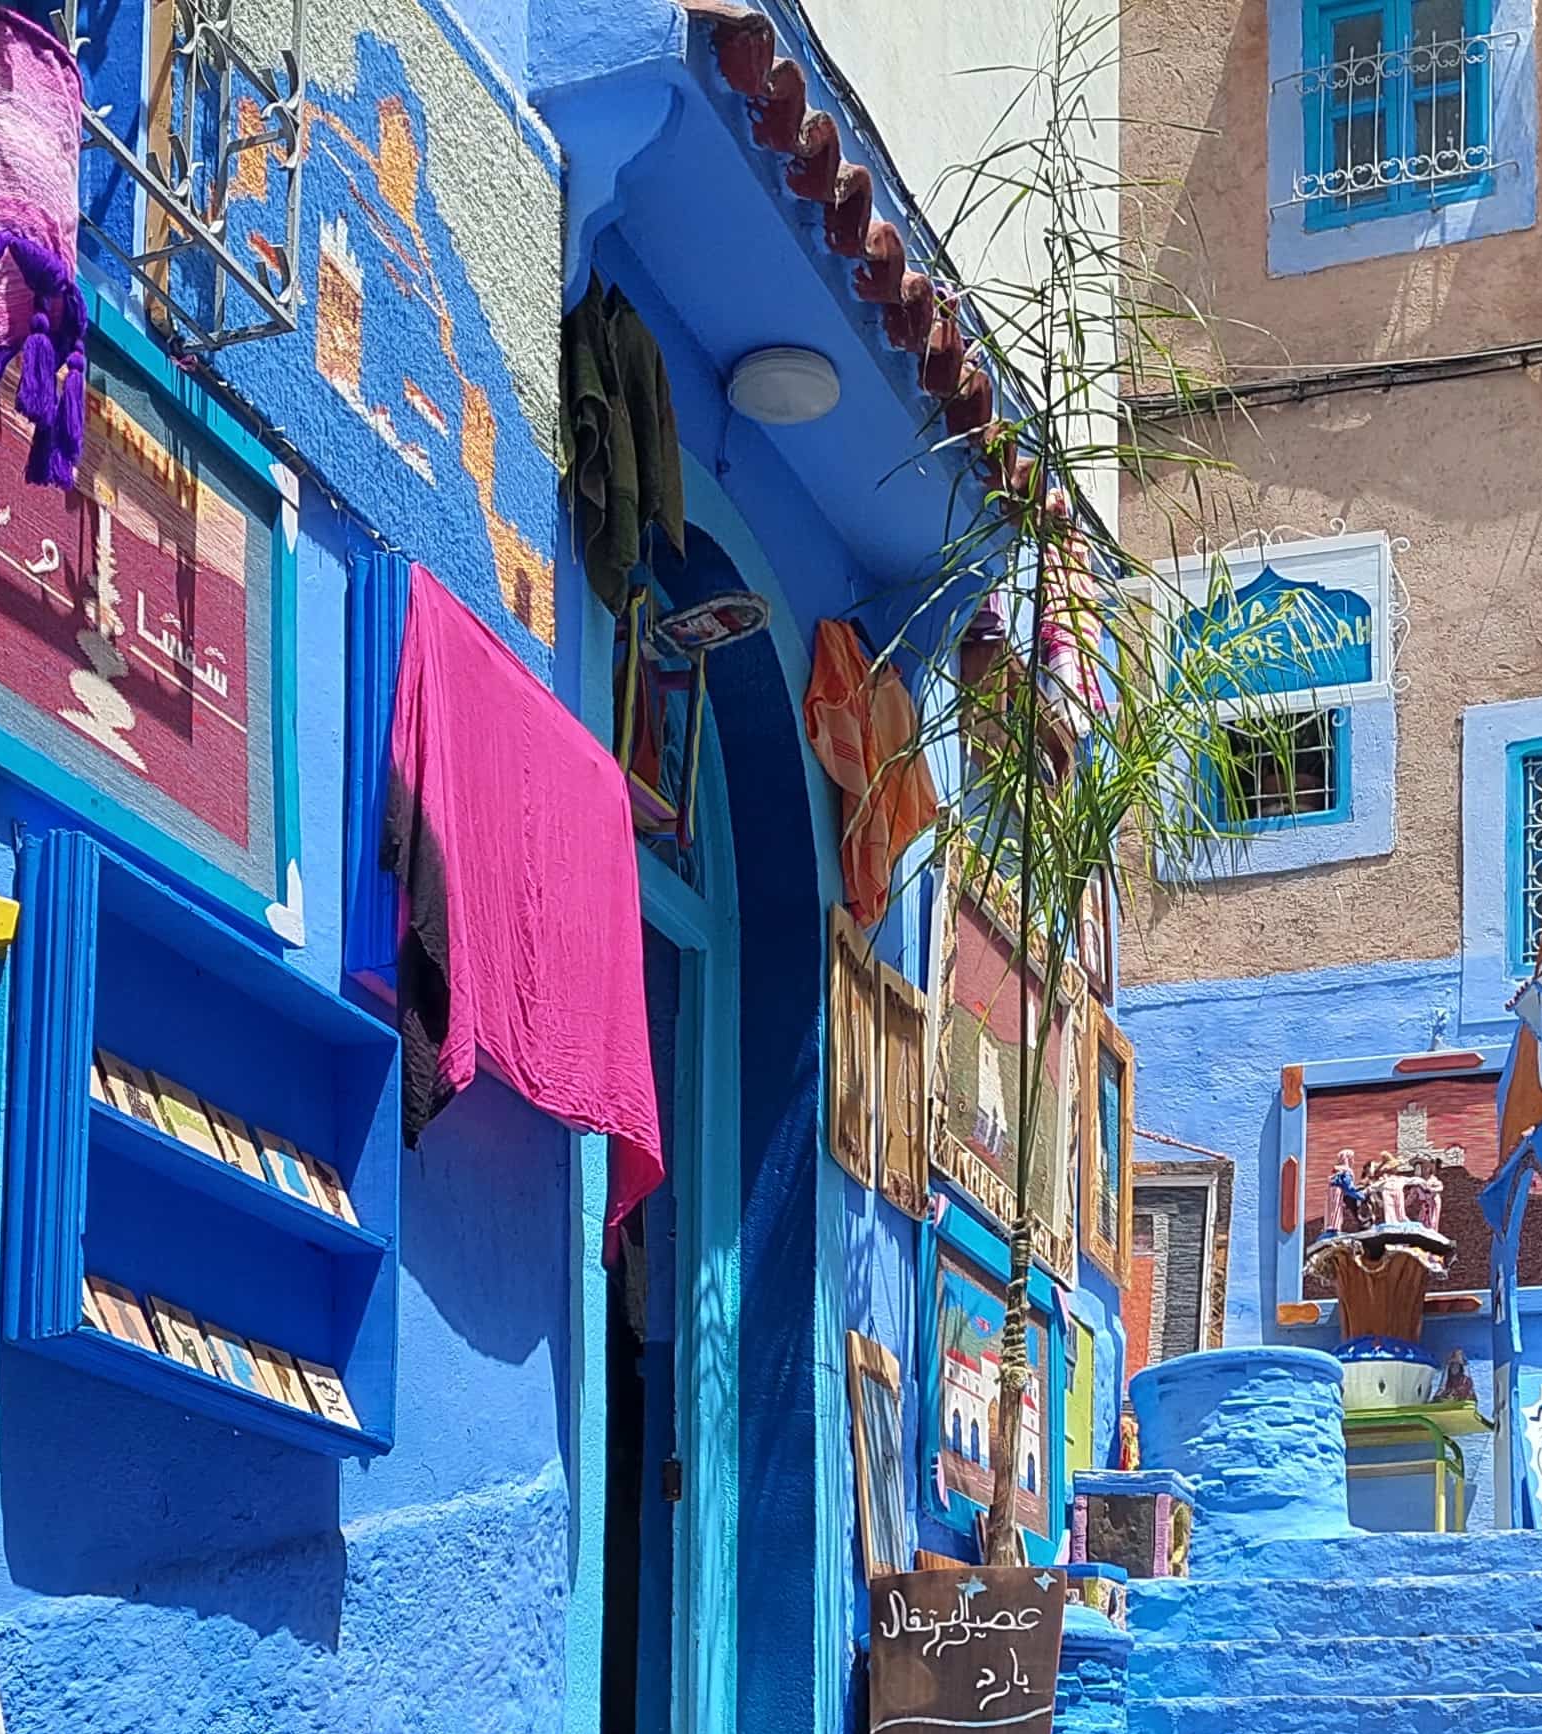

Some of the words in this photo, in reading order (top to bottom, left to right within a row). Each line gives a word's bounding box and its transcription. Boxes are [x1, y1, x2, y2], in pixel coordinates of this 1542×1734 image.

[880, 1589, 970, 1657] البرتقال
[937, 1607, 1043, 1657] عصير
[976, 1647, 1031, 1711] بارد
